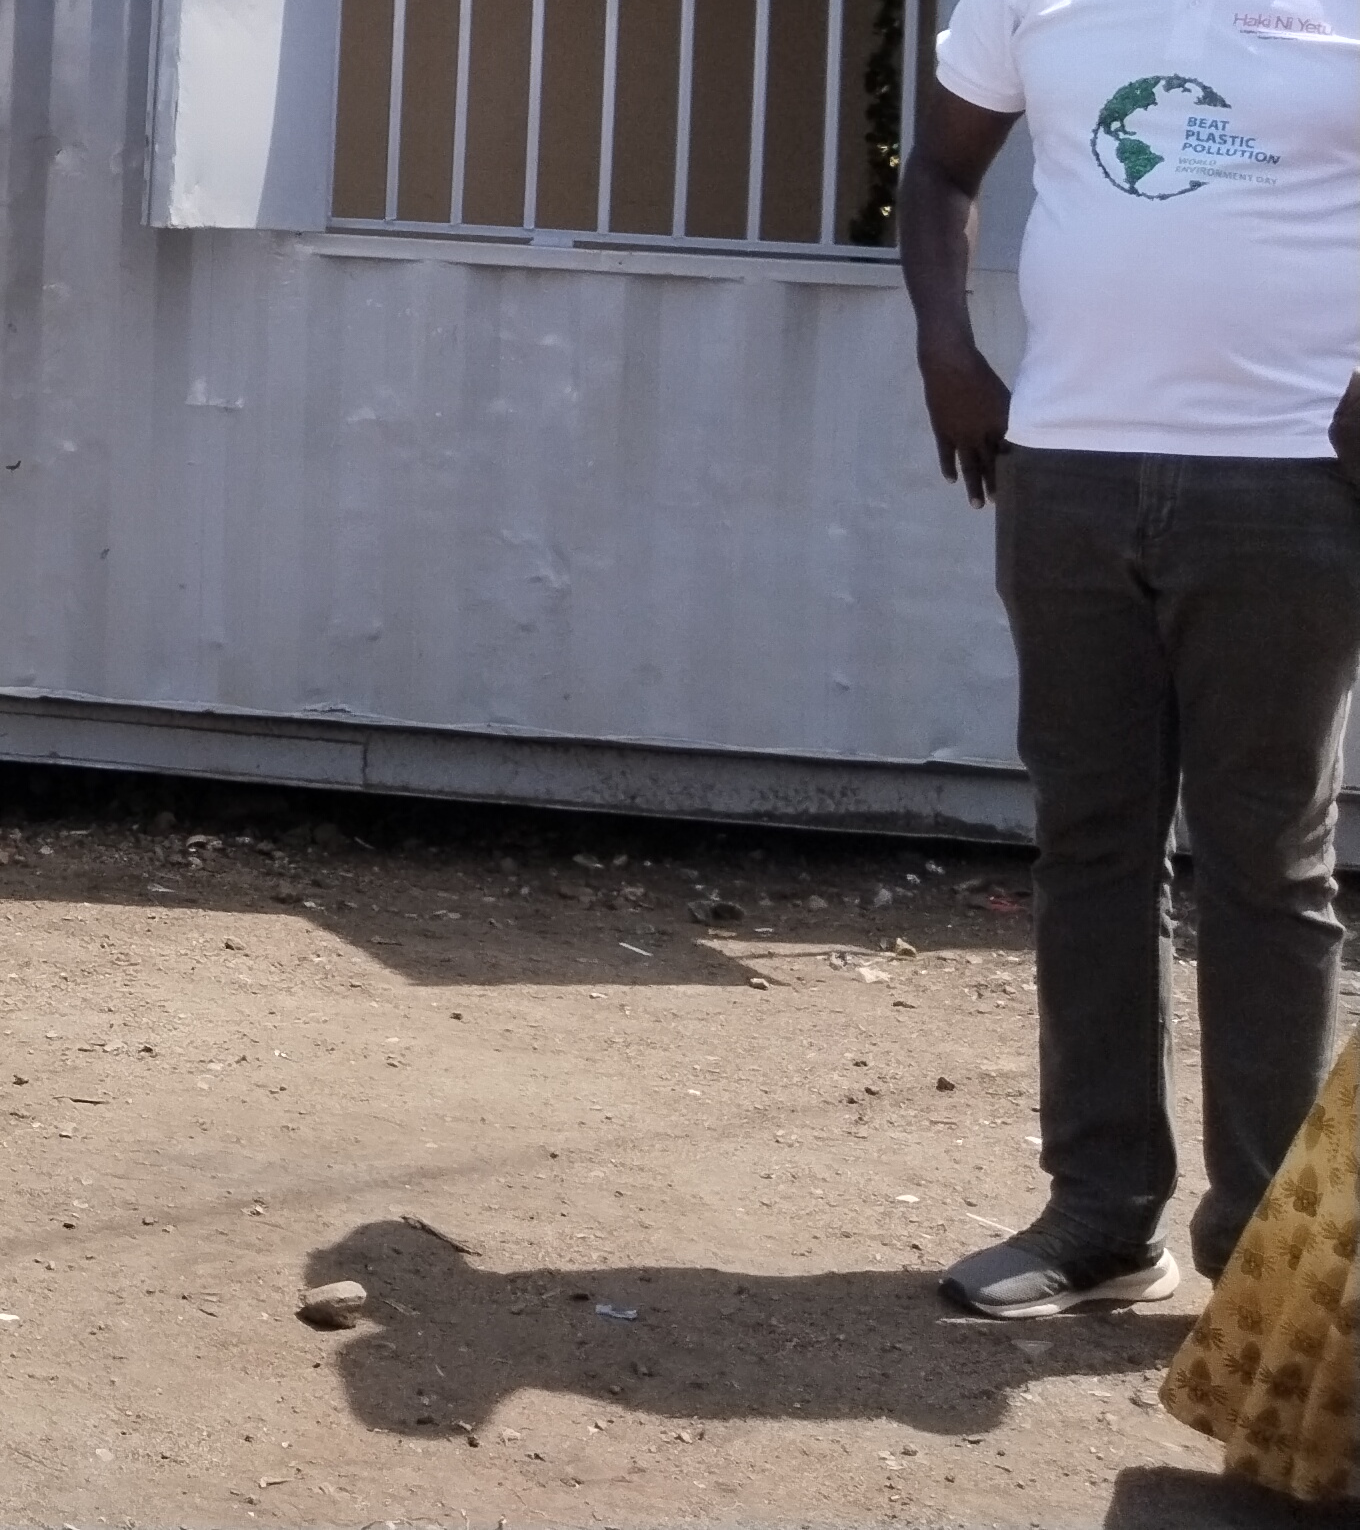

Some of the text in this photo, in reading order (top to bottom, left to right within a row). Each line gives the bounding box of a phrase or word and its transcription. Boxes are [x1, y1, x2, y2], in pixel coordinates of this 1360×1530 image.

[1233, 13, 1272, 29] Haki
[1275, 15, 1294, 30] Ni
[1297, 17, 1333, 36] Yetu
[1186, 116, 1230, 131] BEAT
[1185, 129, 1257, 149] PLASTIC
[1178, 157, 1217, 166] WORLD
[1181, 142, 1281, 165] POLLUTION
[1174, 165, 1253, 182] ENVIRONMENT
[1255, 176, 1279, 185] DAY
